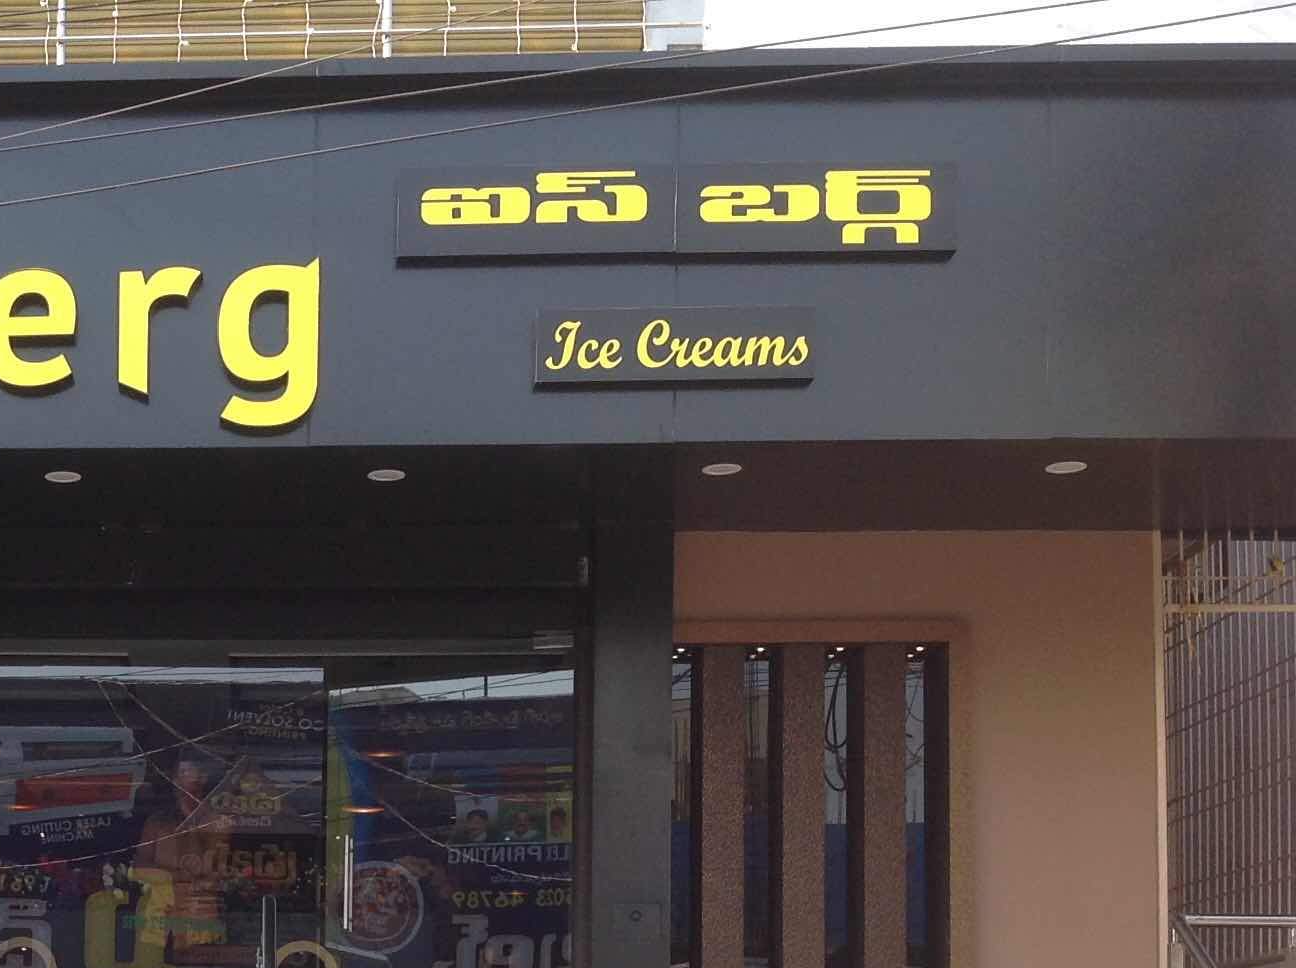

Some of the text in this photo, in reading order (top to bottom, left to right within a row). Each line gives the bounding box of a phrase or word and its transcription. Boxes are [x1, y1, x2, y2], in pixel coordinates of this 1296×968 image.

[420, 170, 649, 226] ఐస్
[545, 319, 810, 370] Ice Creams
